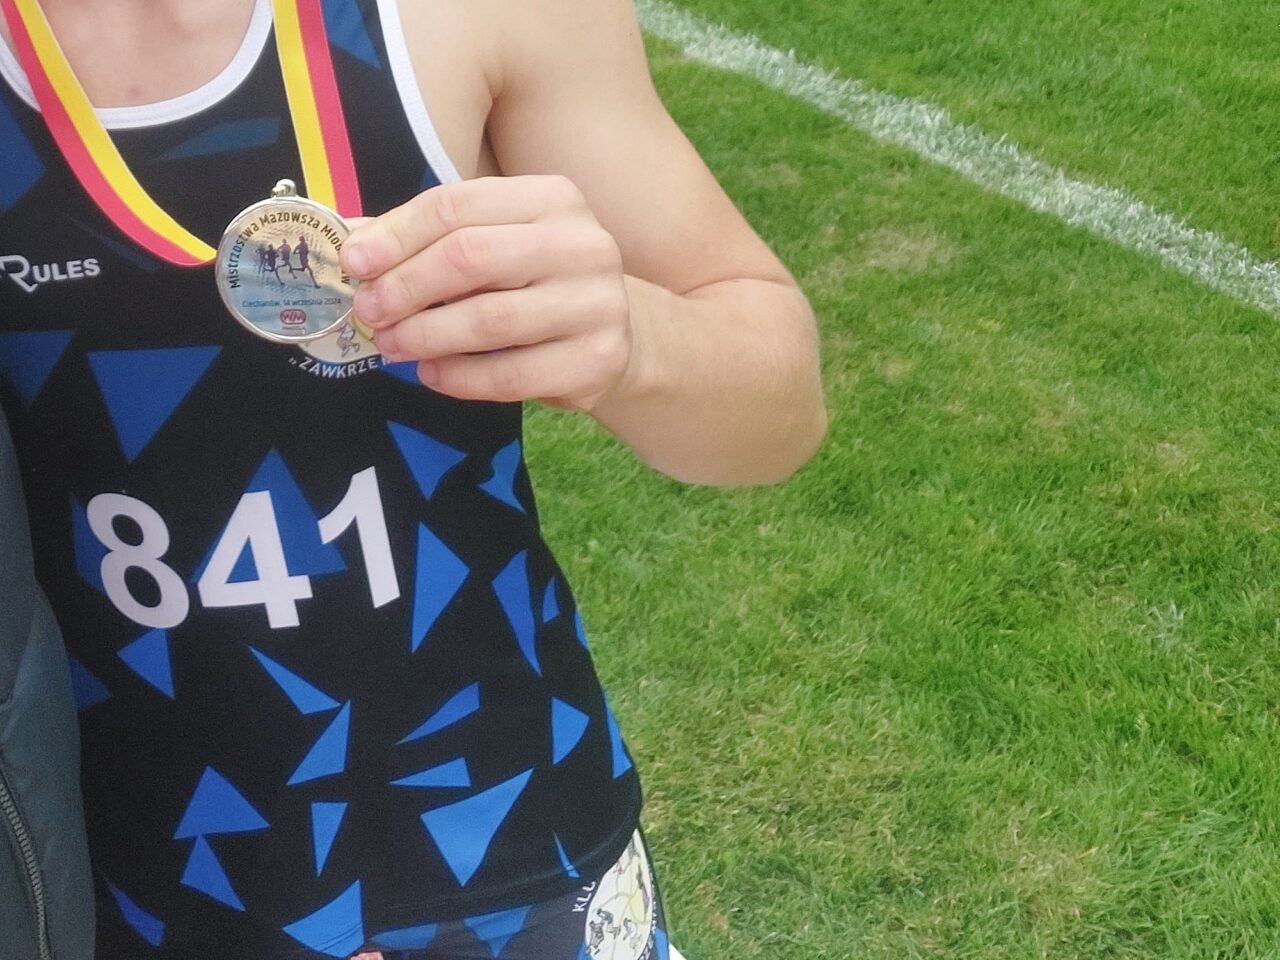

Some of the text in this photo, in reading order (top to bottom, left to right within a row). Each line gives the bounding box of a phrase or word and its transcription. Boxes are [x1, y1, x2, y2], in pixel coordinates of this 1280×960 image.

[226, 222, 260, 289] Mistrzostwa
[258, 211, 321, 230] Mazowsza
[87, 465, 401, 630] 841
